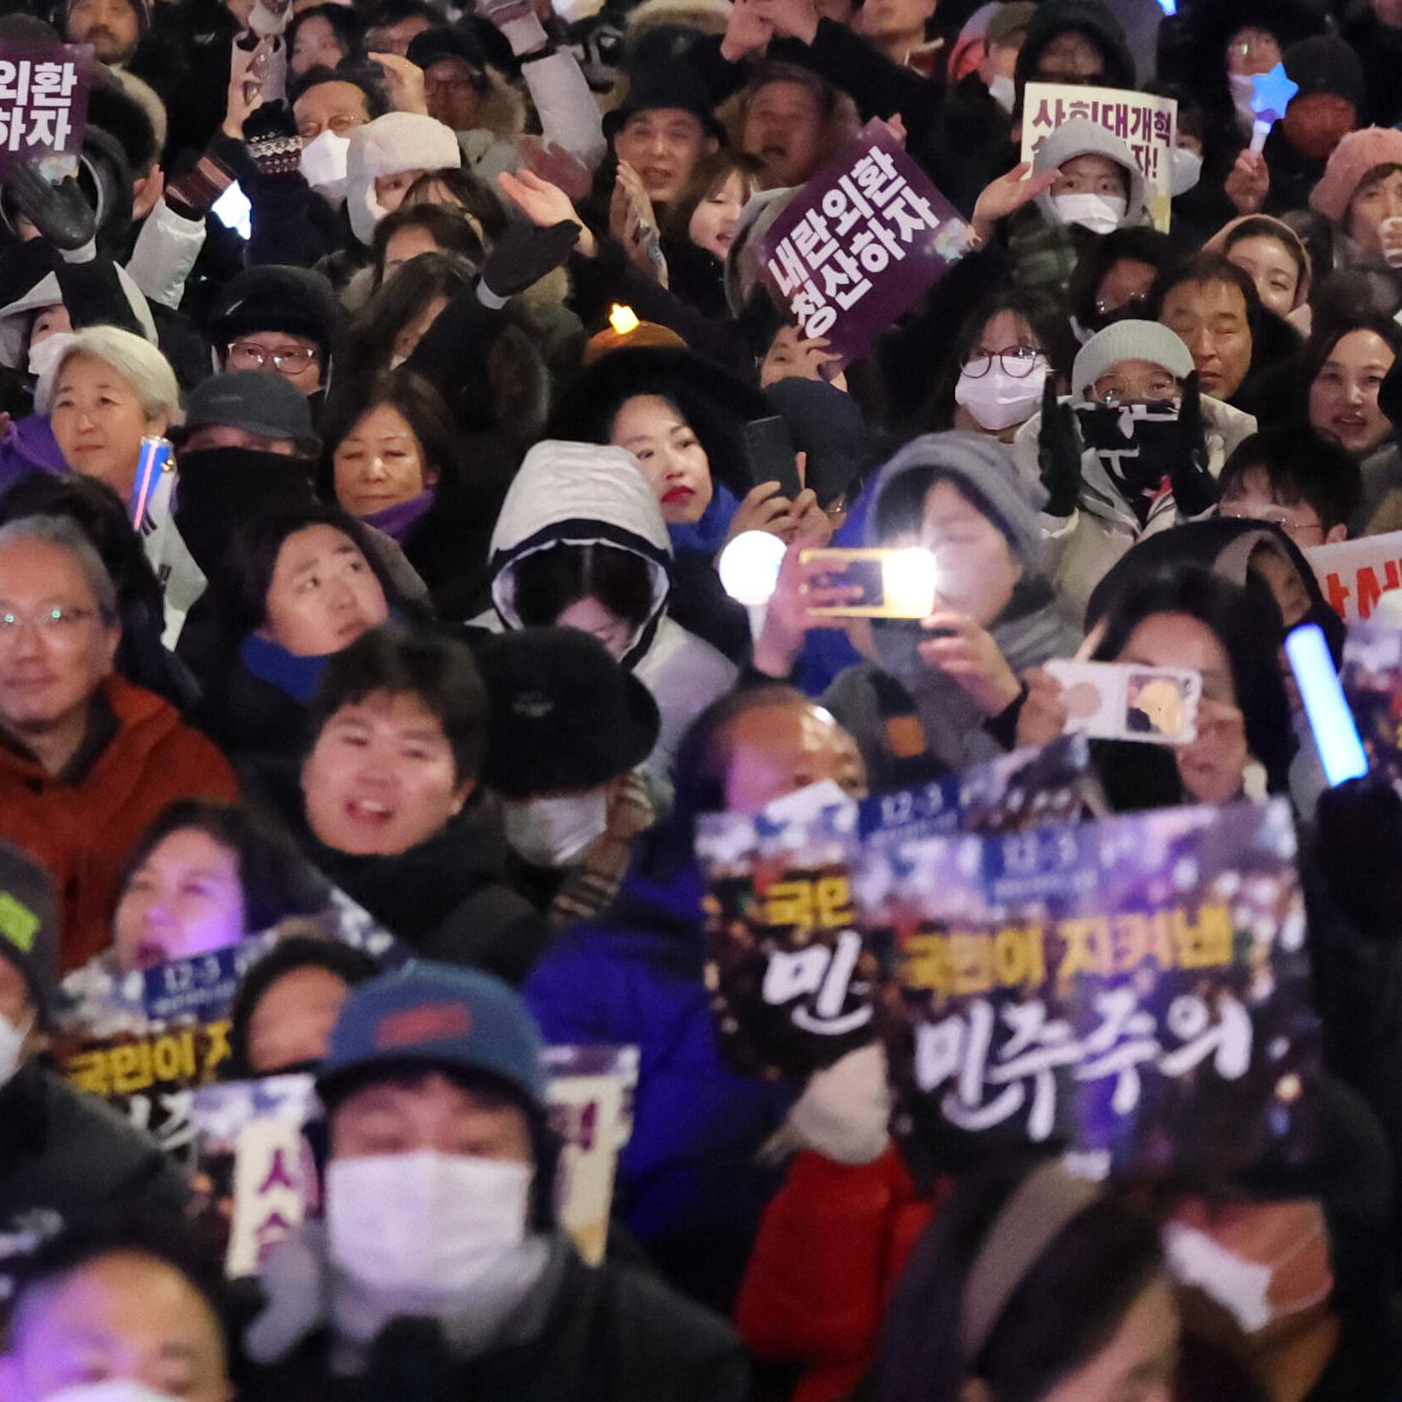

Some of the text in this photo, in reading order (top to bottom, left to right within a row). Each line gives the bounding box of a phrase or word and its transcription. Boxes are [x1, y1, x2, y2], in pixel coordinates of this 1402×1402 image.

[766, 144, 908, 299] 내란외환
[792, 185, 941, 339] 청산하자
[764, 876, 852, 940] 국민
[902, 918, 1047, 996] 국민이
[913, 988, 1253, 1144] 민주주의
